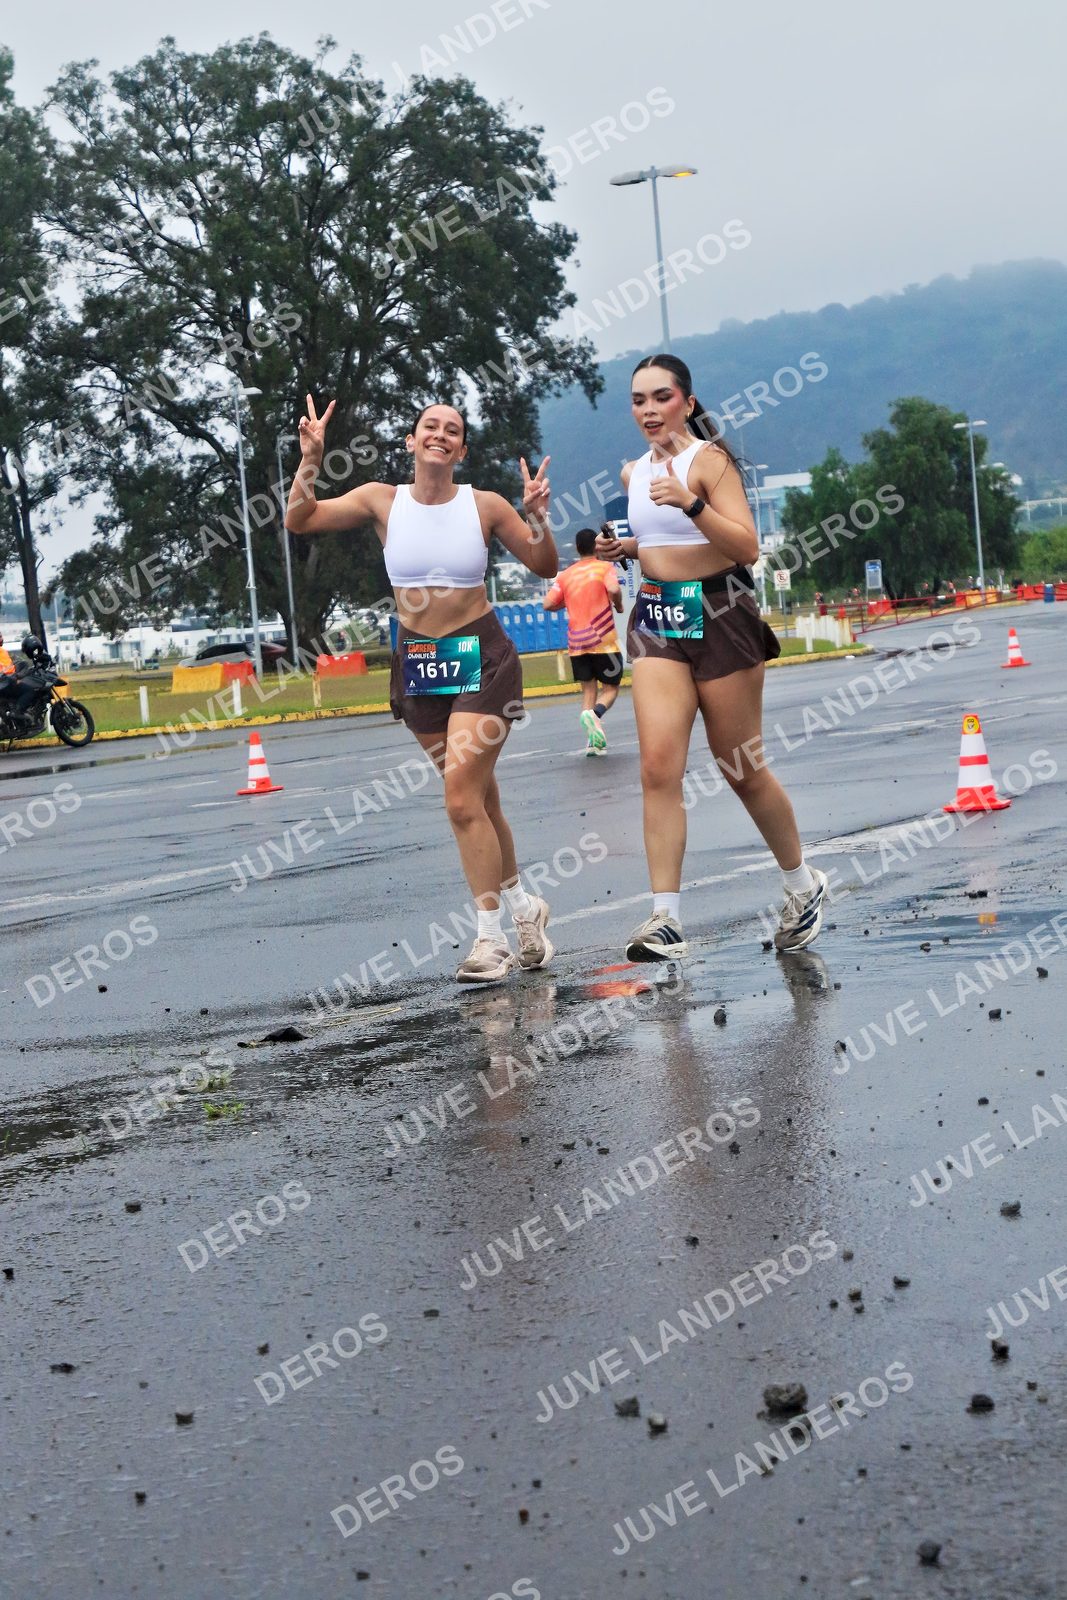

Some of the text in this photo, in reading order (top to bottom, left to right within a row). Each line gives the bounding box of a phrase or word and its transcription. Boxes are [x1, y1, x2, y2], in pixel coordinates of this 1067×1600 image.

[681, 586, 697, 598] 10K
[646, 603, 686, 623] 1616
[458, 641, 473, 653] 10K
[417, 661, 461, 679] 1617
